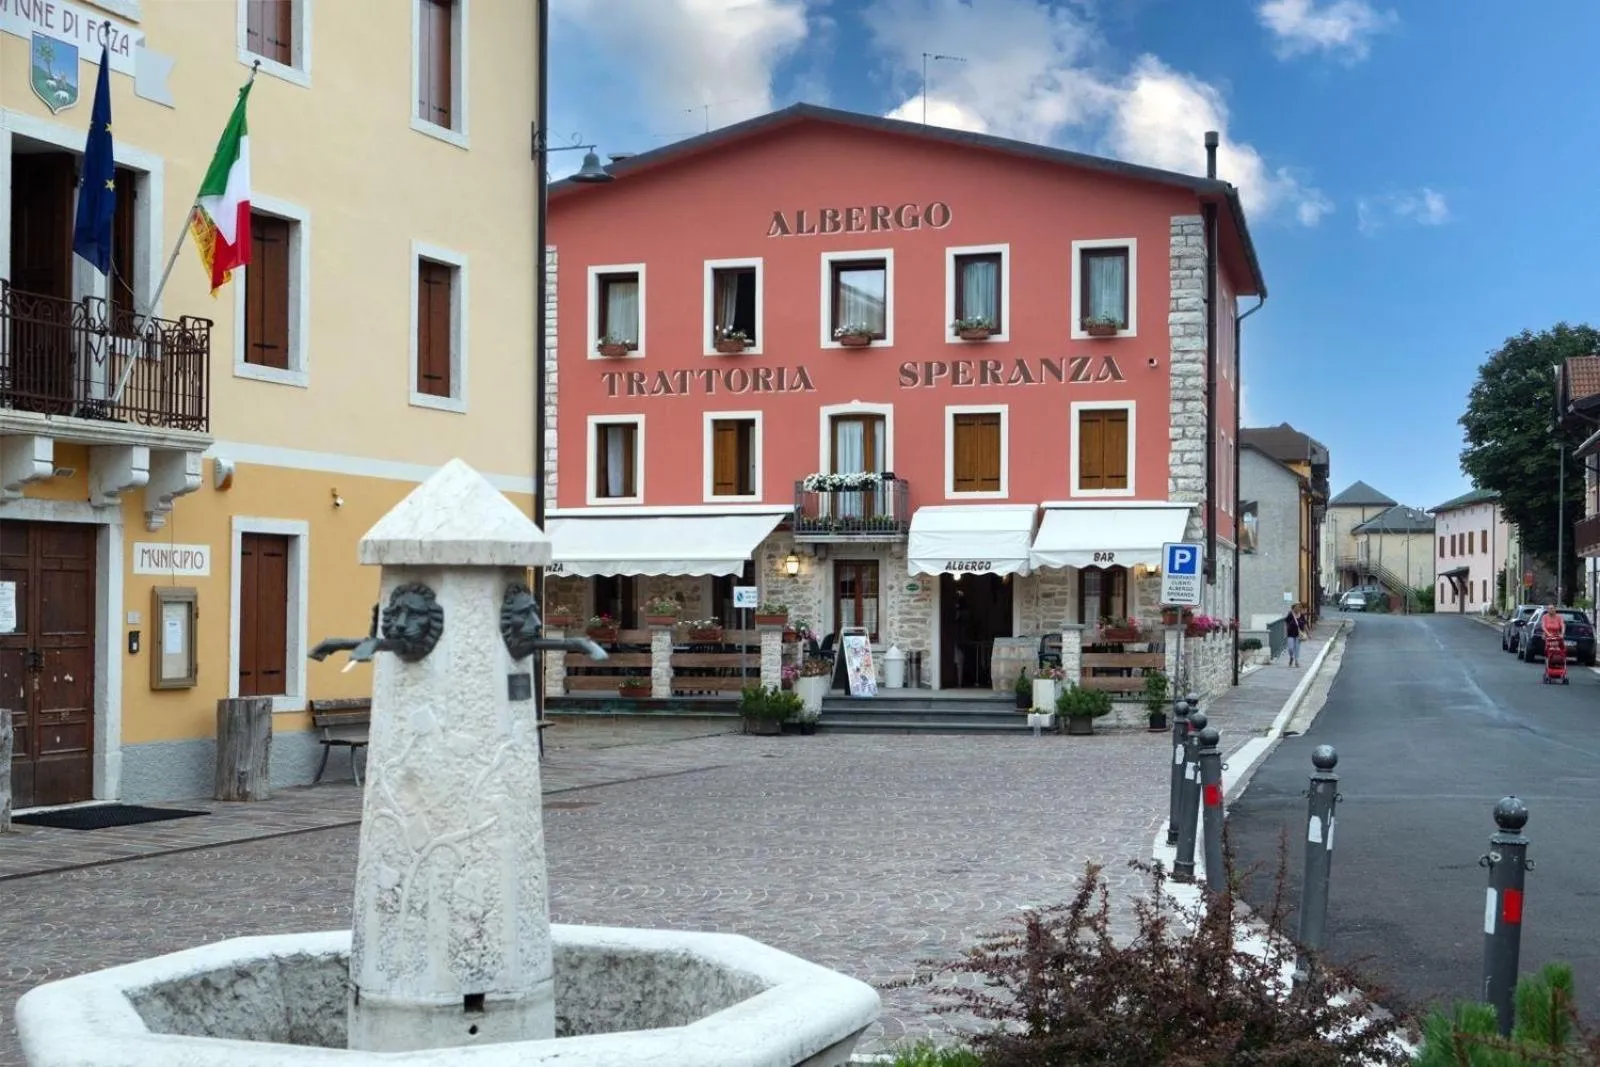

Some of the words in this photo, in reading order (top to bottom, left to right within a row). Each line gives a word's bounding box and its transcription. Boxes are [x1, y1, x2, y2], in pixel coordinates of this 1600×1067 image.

[63, 9, 79, 38] DI
[87, 19, 129, 57] FOZA
[767, 201, 953, 238] ALBERGO
[601, 365, 817, 398] TRATTORIA
[899, 355, 1128, 389] SPERANZA
[140, 548, 204, 569] MUNICIPIO
[945, 560, 992, 572] ALBERGO
[1093, 552, 1115, 563] BAR
[1174, 549, 1191, 571] P
